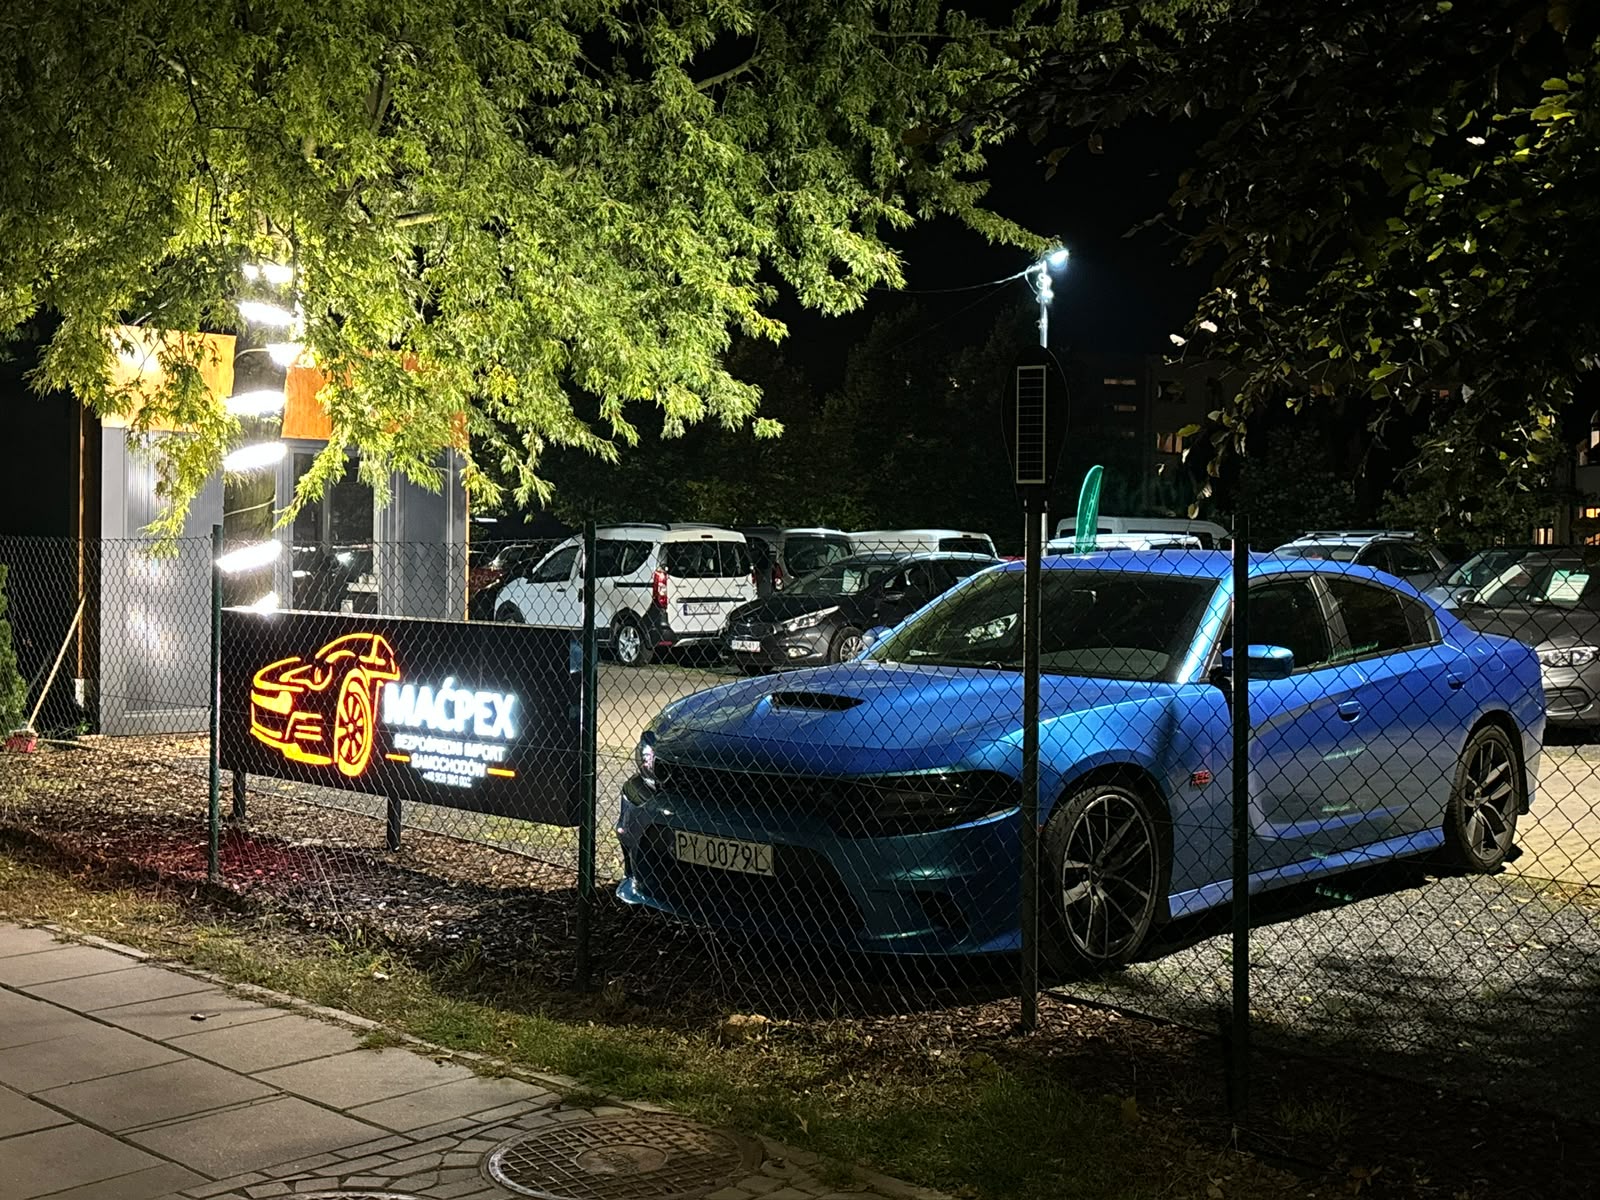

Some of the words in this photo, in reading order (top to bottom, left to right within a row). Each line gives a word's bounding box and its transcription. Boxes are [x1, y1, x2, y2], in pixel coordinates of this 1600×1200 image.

[383, 676, 515, 738] MAĆPEX
[411, 753, 486, 777] SAMOCHODÓW
[464, 742, 506, 761] IMPORT
[678, 833, 698, 859] PY
[706, 839, 768, 872] 0079L
